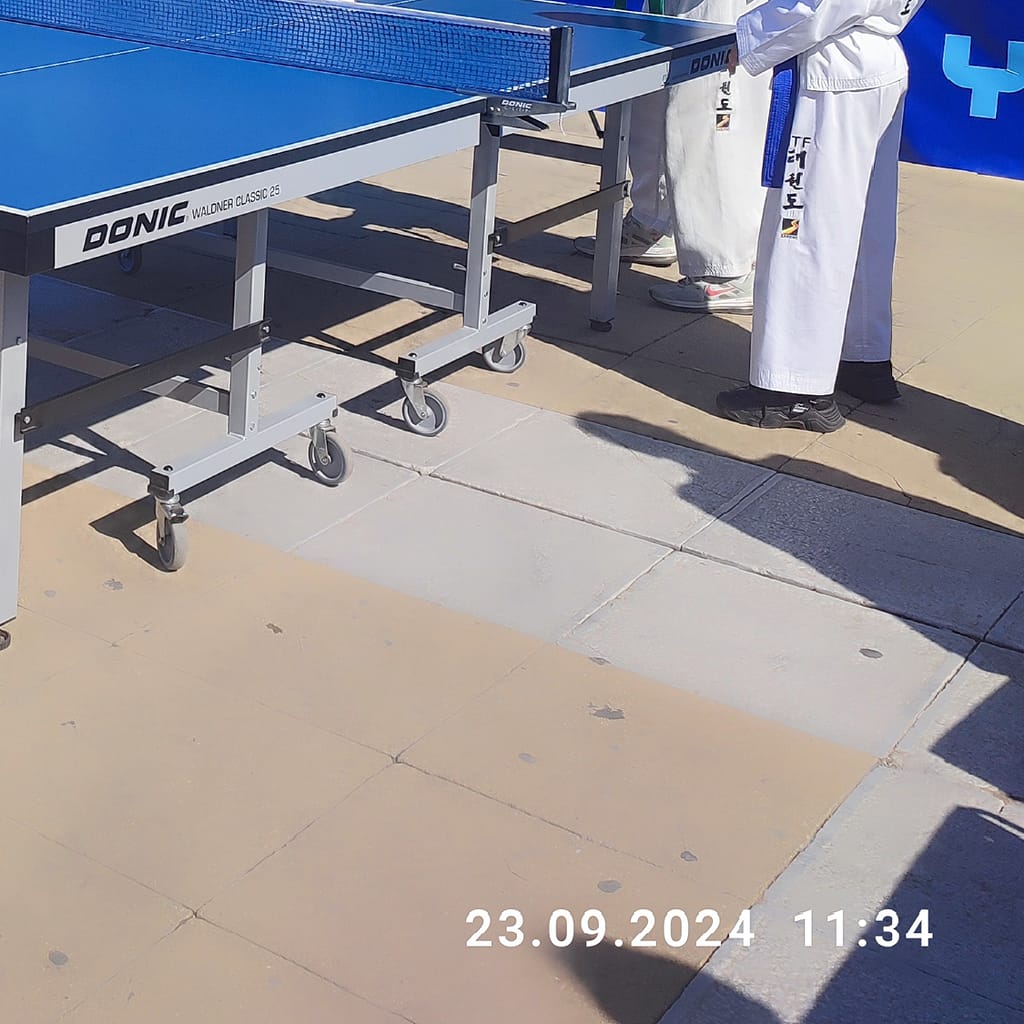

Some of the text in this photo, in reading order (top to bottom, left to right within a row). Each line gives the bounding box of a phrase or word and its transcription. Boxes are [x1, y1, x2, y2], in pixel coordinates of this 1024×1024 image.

[501, 98, 533, 110] DONIC
[790, 135, 812, 148] TF
[82, 184, 280, 253] DONIC WALDNER CLASSIC 25
